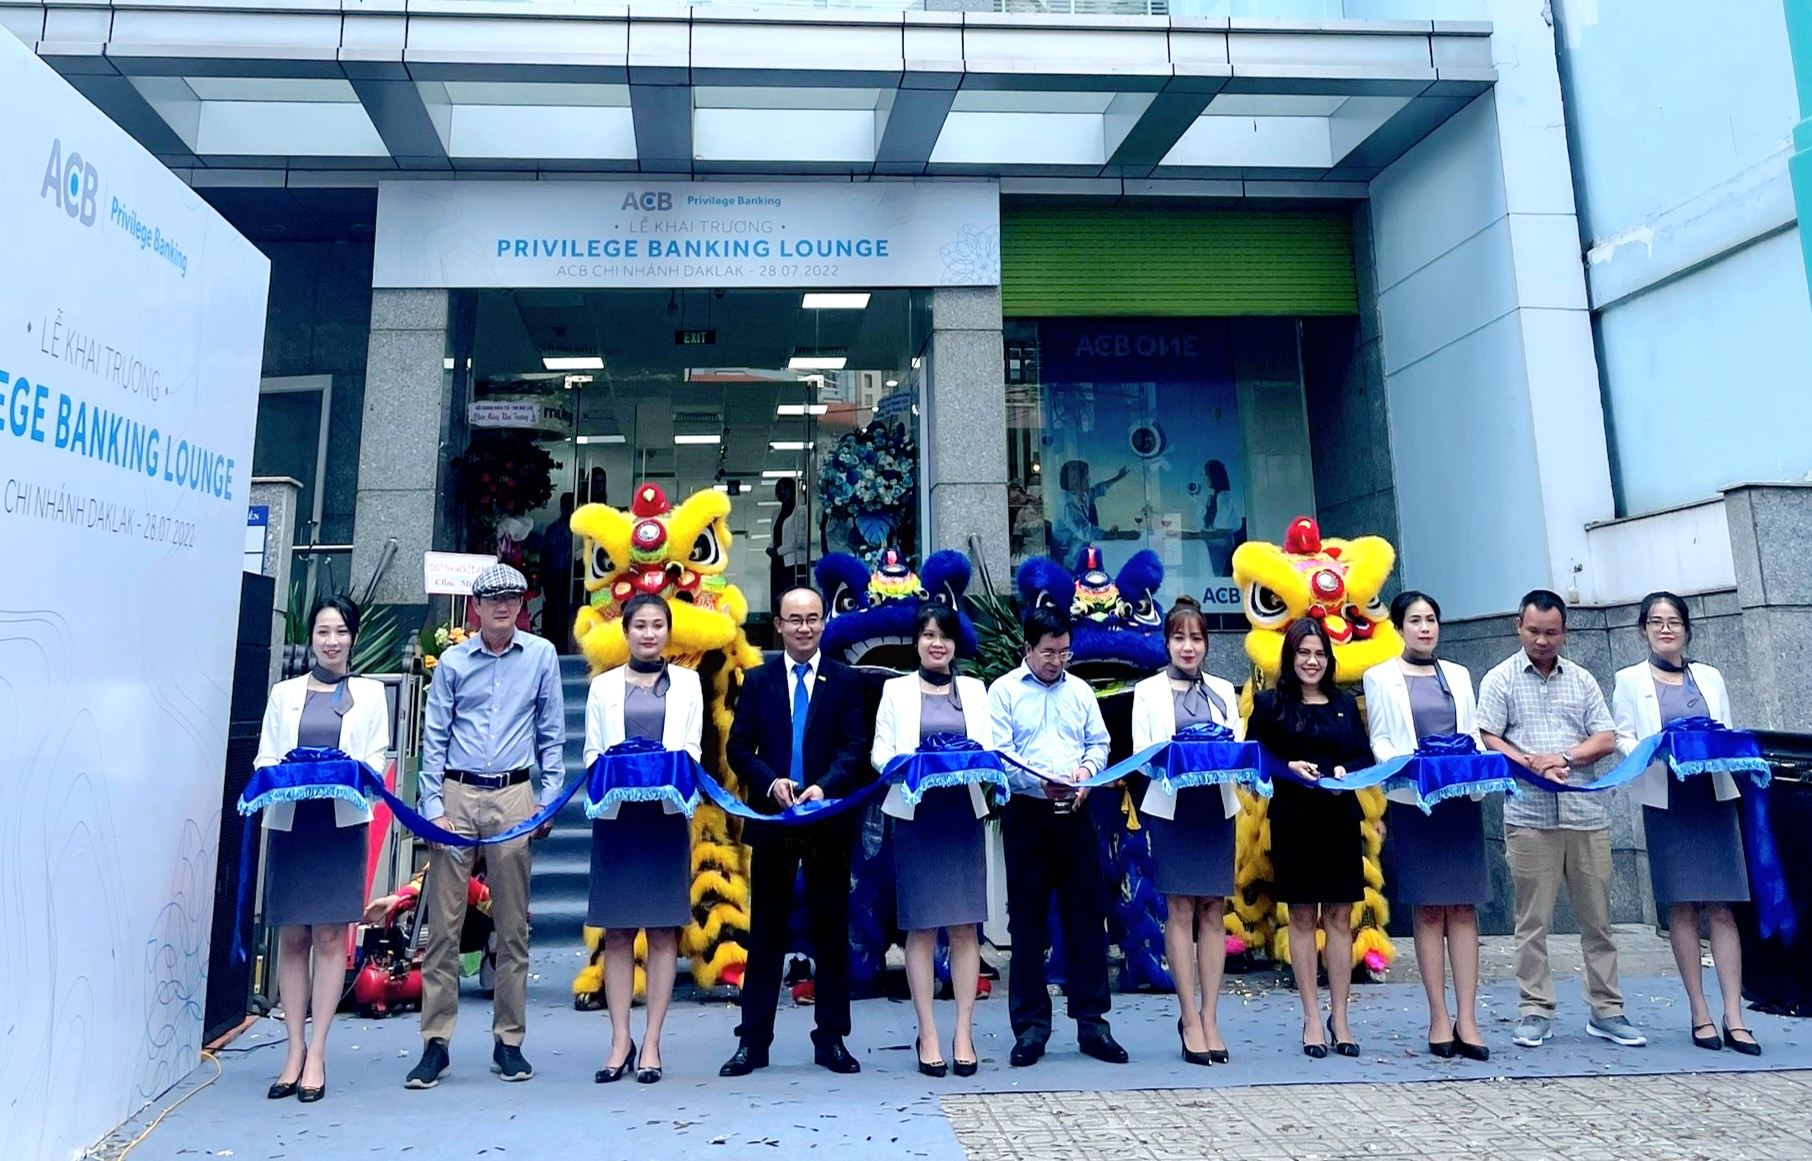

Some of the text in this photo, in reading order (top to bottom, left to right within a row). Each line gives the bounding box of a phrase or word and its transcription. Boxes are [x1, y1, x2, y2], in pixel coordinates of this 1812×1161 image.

[40, 137, 99, 227] ACB
[621, 191, 673, 212] ACB
[687, 196, 782, 208] Privilege Banking
[629, 216, 773, 234] LỄ KHAI TRƯƠNG
[110, 195, 188, 278] Privilege Banking
[497, 239, 890, 258] PRIVILEGE BANKING LOUNGE
[556, 264, 588, 277] ACB
[592, 264, 619, 277] CHI
[623, 263, 680, 277] NHÁNH
[683, 264, 744, 277] DAKLAK
[759, 264, 840, 277] 28.07.2022
[684, 331, 707, 344] EXIT
[1074, 333, 1131, 357] ACB
[41, 308, 161, 402] LỄ KHAI TRƯƠNG
[55, 393, 160, 477] BANKING
[164, 435, 235, 501] LOUNGE
[4, 478, 32, 516] CHI
[34, 483, 87, 525] NHÁNH
[87, 498, 136, 535] DAKLAK
[143, 512, 196, 548] 28.07.2022
[1202, 586, 1241, 605] ACB
